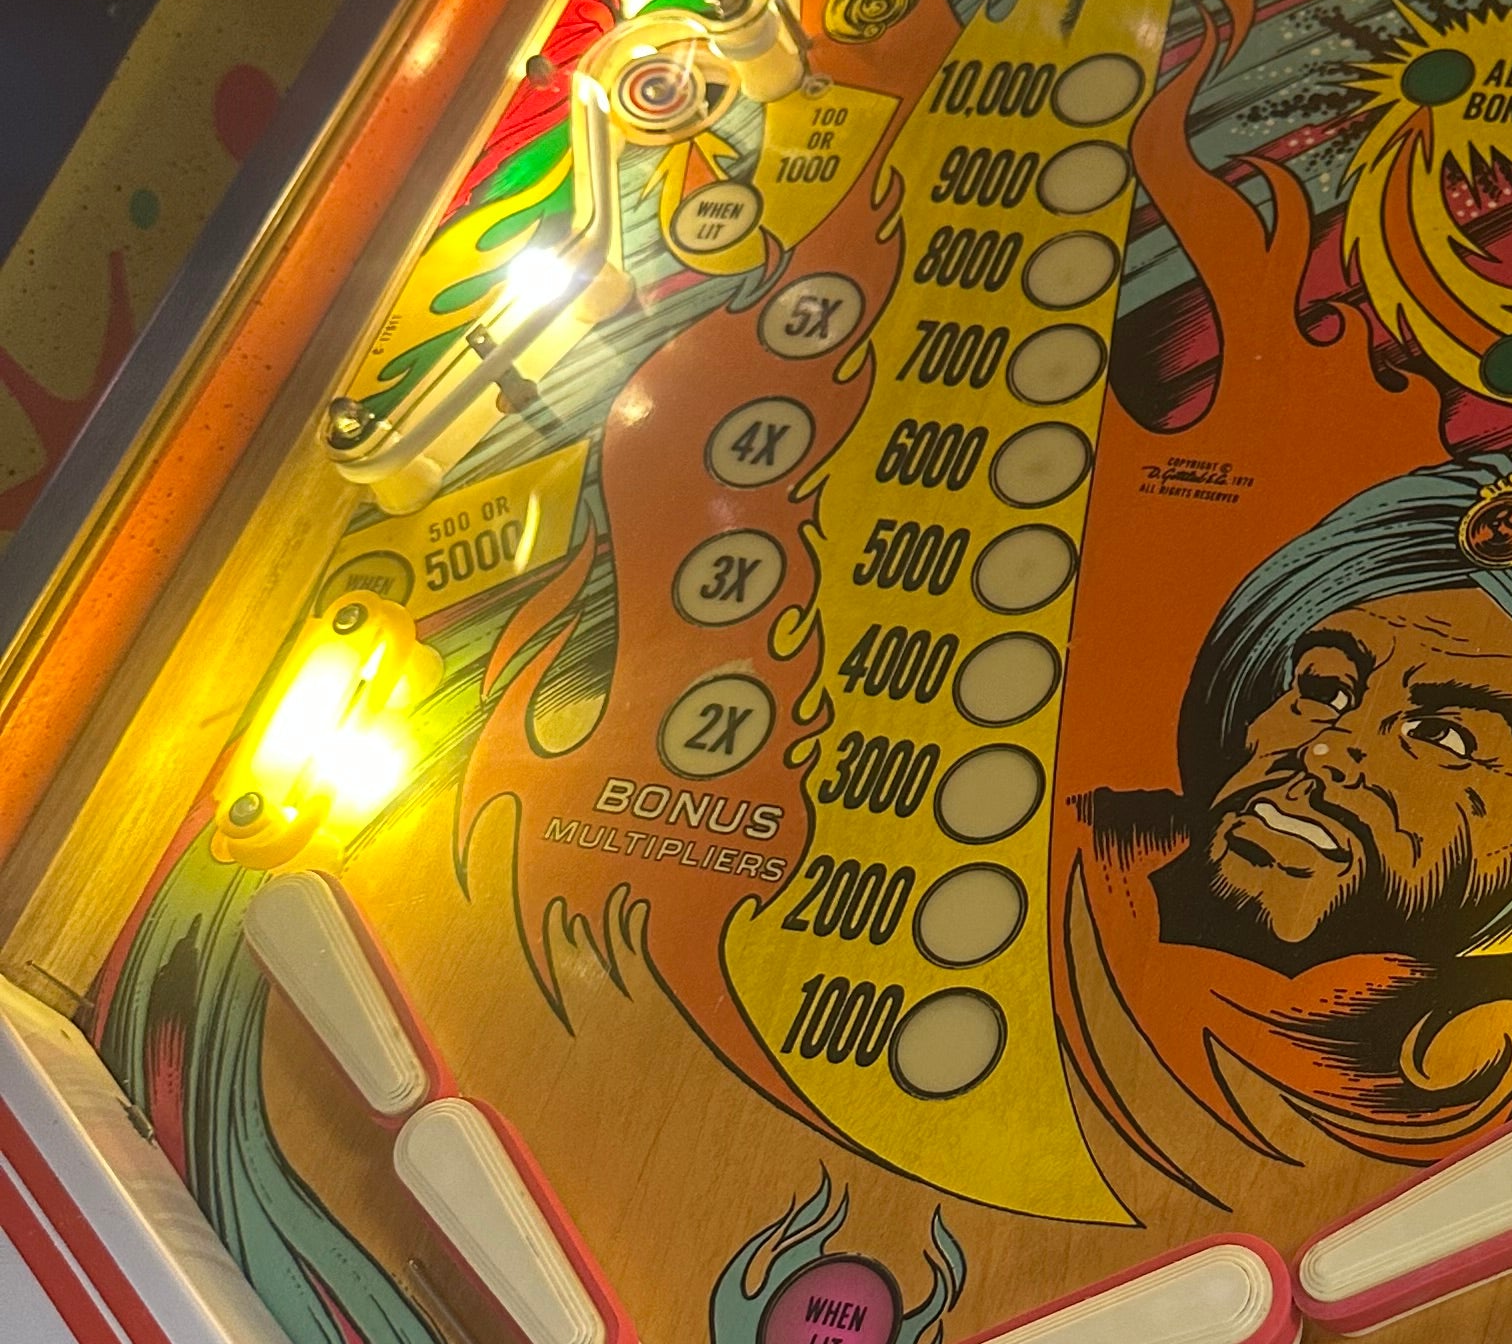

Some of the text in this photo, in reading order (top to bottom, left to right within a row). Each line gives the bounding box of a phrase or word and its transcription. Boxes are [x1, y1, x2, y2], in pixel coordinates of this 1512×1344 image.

[811, 107, 850, 128] 100
[928, 59, 1058, 120] 10,000
[775, 155, 842, 184] 1000
[807, 131, 836, 151] OR
[930, 145, 1041, 210] 9000
[696, 200, 746, 221] WHEN
[696, 223, 726, 241] LIT
[912, 224, 1025, 294] 8000
[784, 294, 845, 340] 5X
[894, 319, 1011, 390] 7000
[729, 420, 793, 468] 4X
[874, 418, 990, 492] 6000
[428, 495, 512, 544] 500 OR
[1138, 482, 1241, 505] ALL RIGHTS RESERVED
[423, 518, 525, 592] 5000
[699, 554, 764, 604] 3X
[852, 518, 972, 596] 5000
[836, 623, 961, 706] 4000
[683, 703, 755, 756] 2X
[817, 730, 942, 819] 3000
[592, 776, 786, 842] BONUS
[542, 816, 789, 884] MULTIPLIERS
[780, 853, 917, 947] 2000
[779, 972, 905, 1069] 1000
[804, 1295, 869, 1333] WHEN
